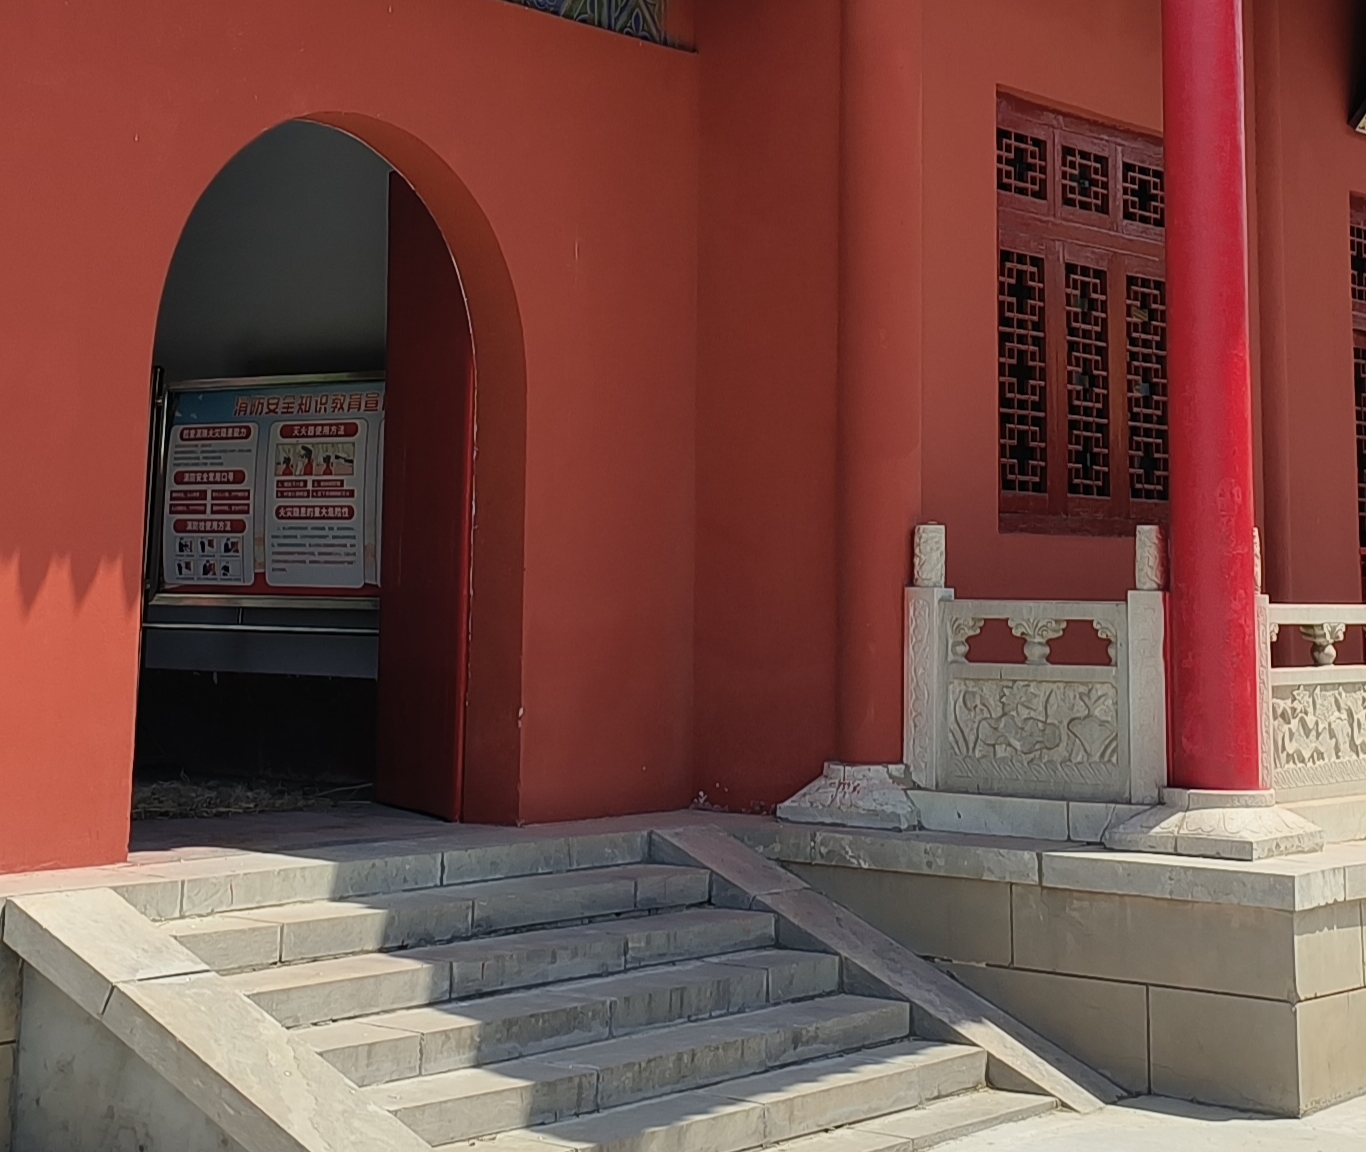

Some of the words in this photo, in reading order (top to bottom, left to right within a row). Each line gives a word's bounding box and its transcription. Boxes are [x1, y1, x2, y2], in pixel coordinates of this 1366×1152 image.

[233, 392, 385, 416] 消防安全知识教育宣
[292, 425, 345, 437] 灭火器使用方法
